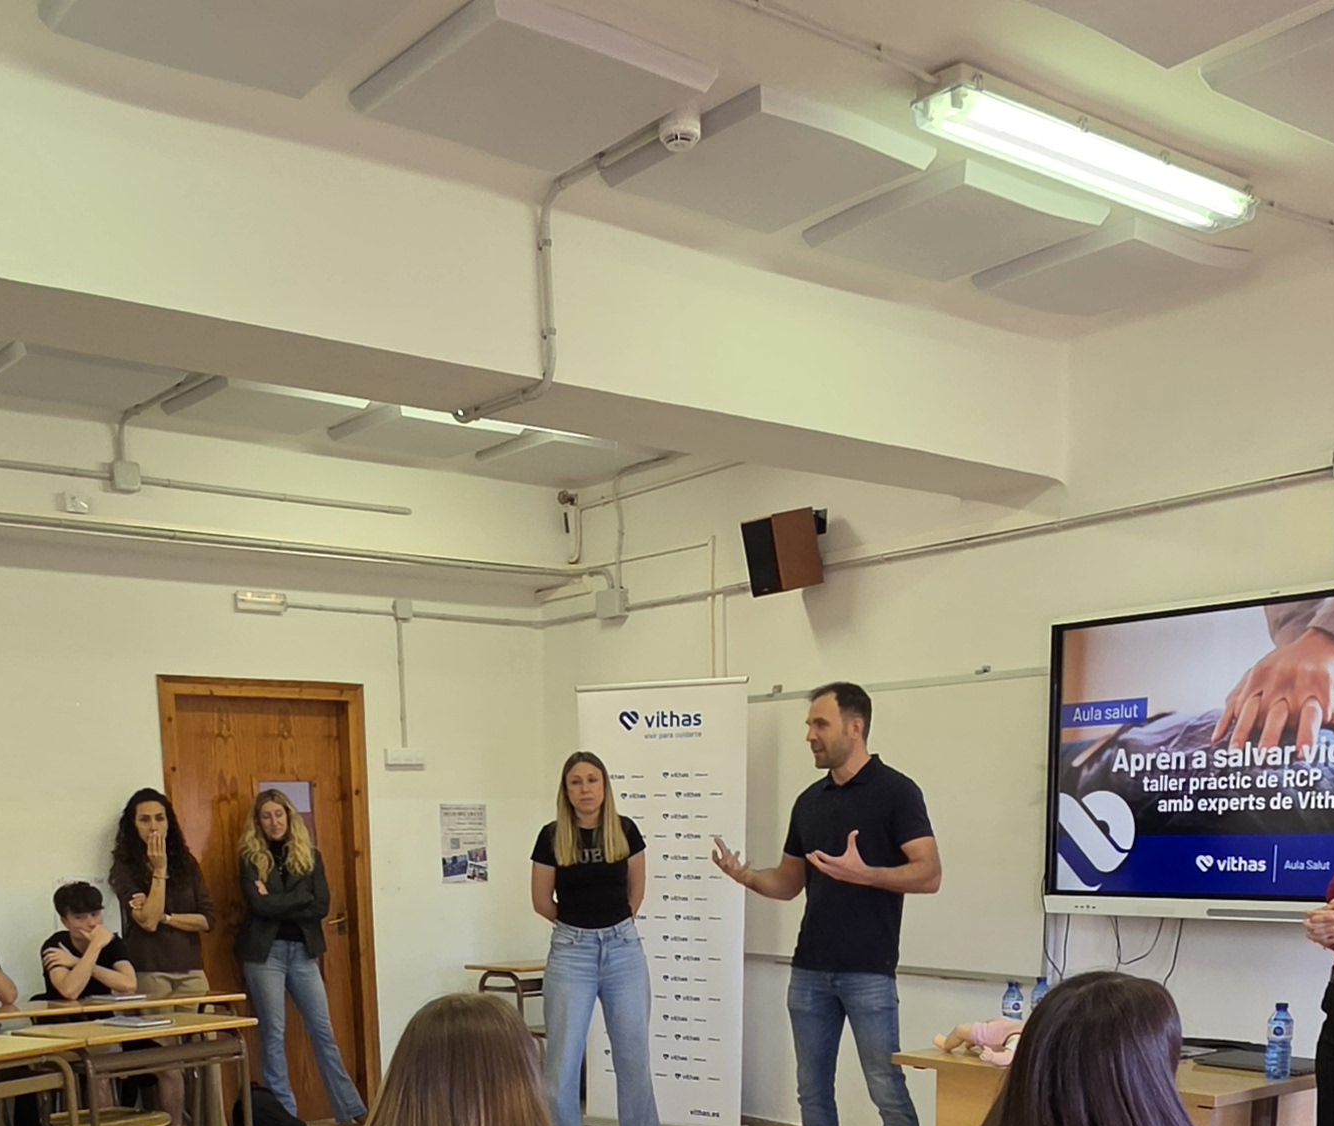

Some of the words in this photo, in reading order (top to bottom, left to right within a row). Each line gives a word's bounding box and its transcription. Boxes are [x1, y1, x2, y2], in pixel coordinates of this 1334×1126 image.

[644, 710, 702, 728] vithas
[1073, 707, 1102, 722] Aula
[1105, 704, 1139, 719] salut
[1112, 746, 1185, 778] Aprèn
[1191, 750, 1207, 769] a
[1213, 741, 1296, 768] salvar
[1142, 775, 1186, 792] taller
[1189, 772, 1251, 795] pràctic
[1256, 771, 1278, 788] de
[1282, 769, 1322, 787] RCP
[1157, 795, 1194, 812] amb
[1197, 793, 1266, 815] experts
[1269, 792, 1293, 810] de
[1217, 856, 1267, 872] vithas
[1284, 859, 1305, 870] Aula
[1306, 859, 1331, 871] Salut
